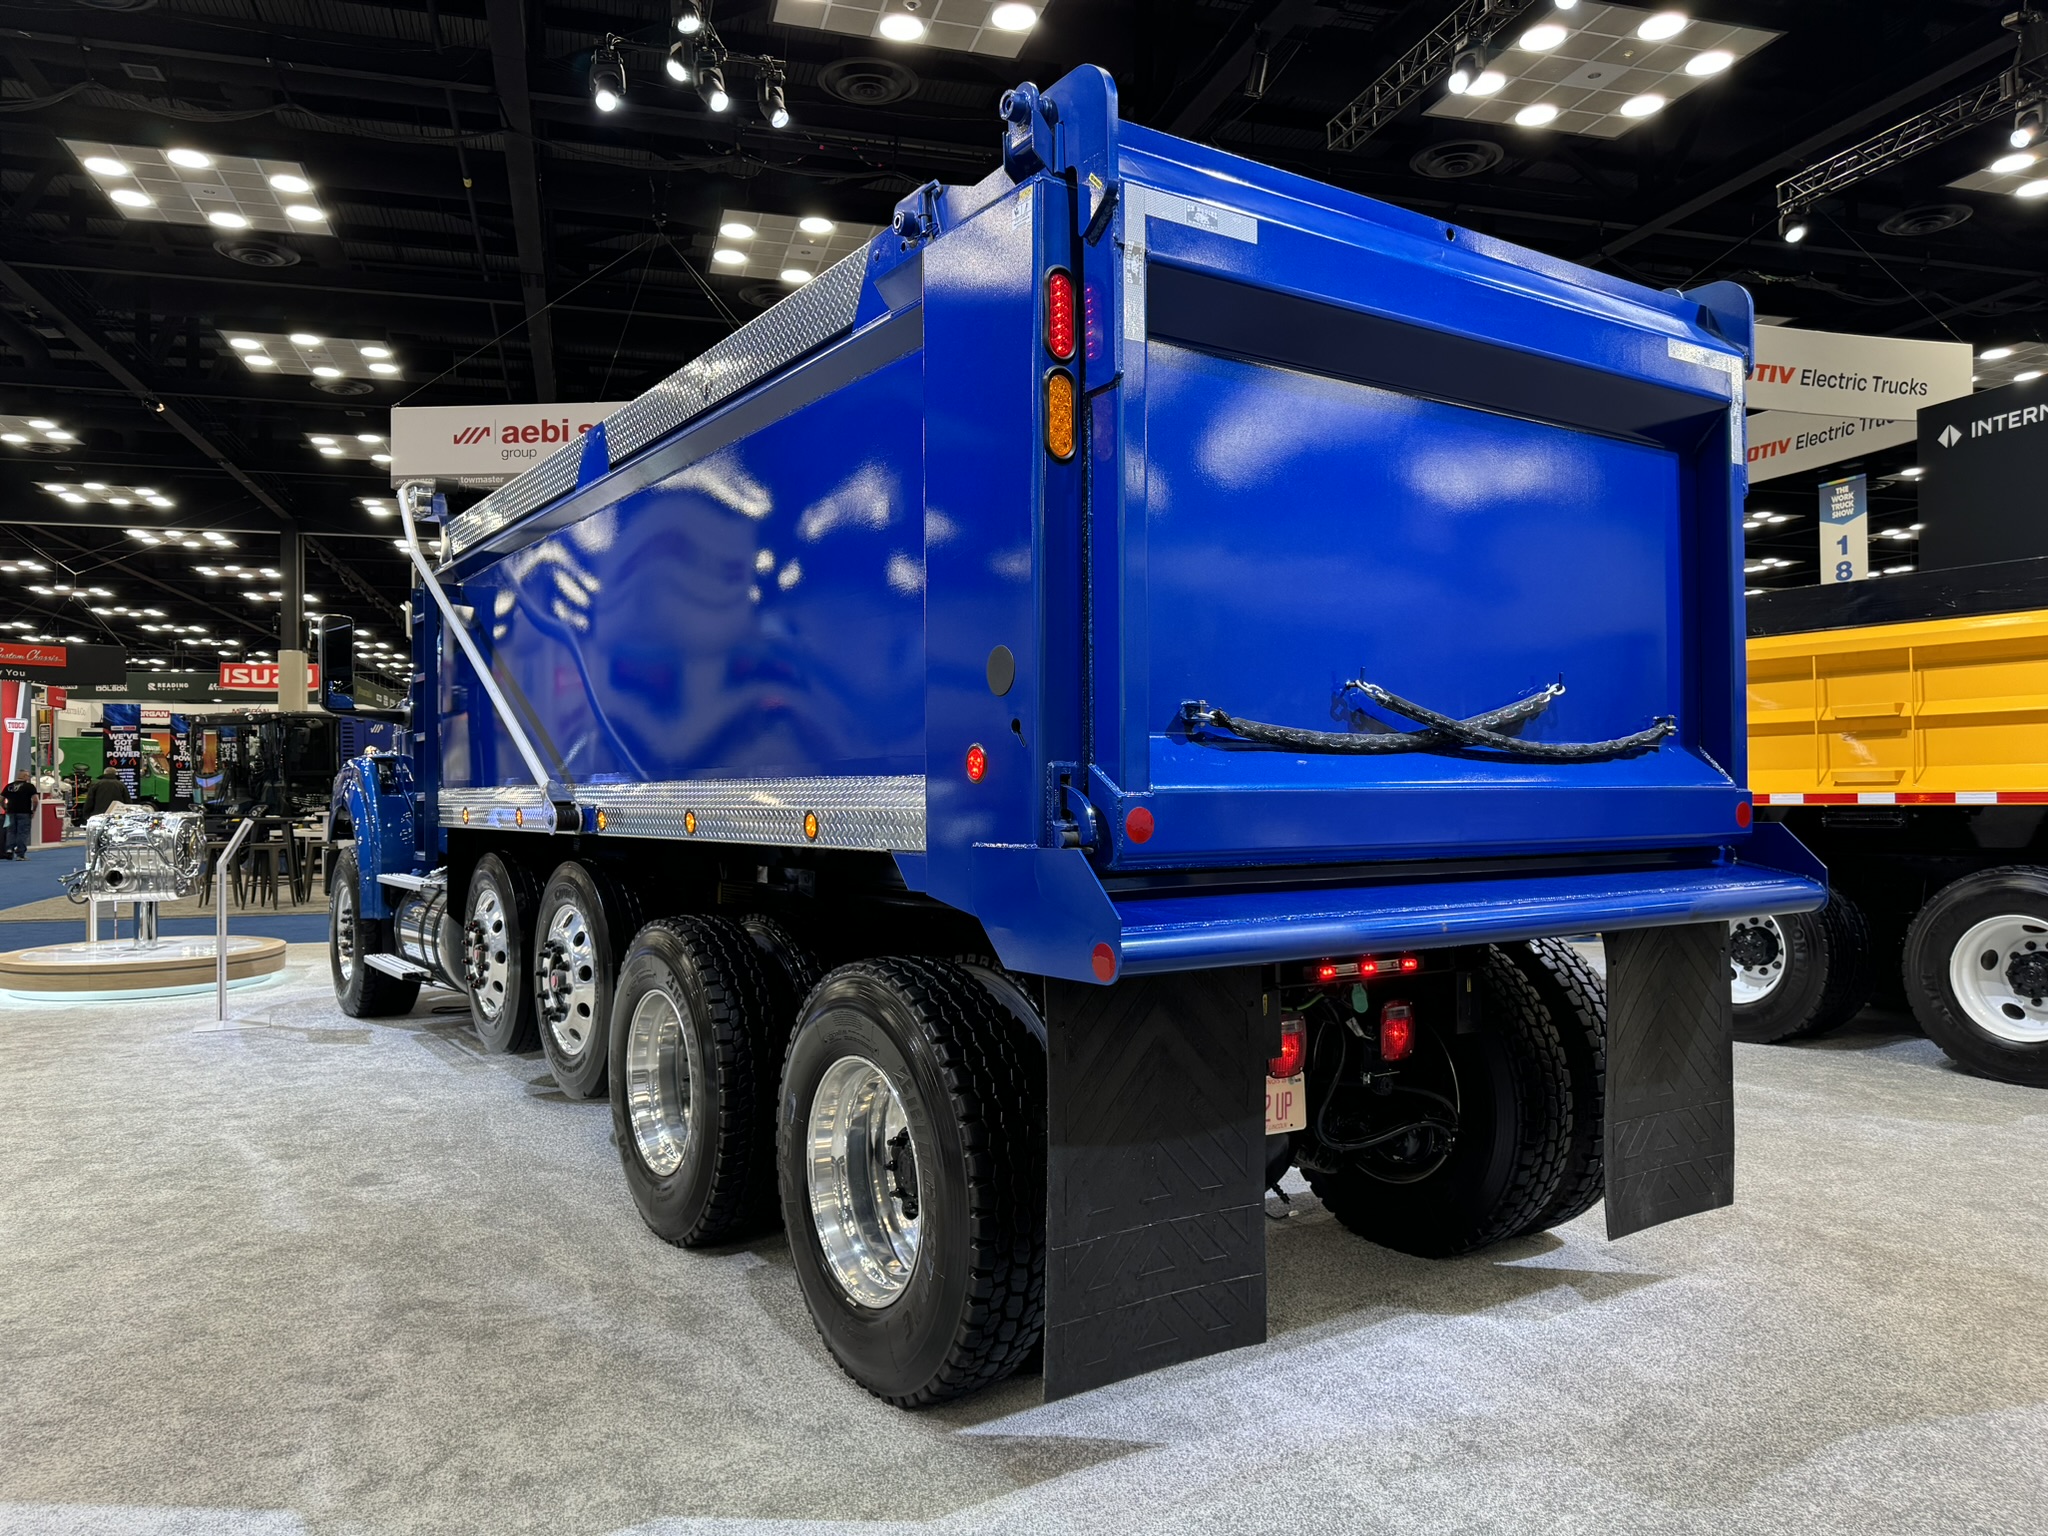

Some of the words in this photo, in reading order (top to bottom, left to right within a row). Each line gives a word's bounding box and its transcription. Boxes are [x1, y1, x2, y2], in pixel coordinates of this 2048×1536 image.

[1747, 363, 1796, 385] TIV
[1799, 369, 1868, 392] Electric
[1871, 375, 1928, 396] Trucks
[1971, 404, 2048, 439] INTERN
[501, 418, 569, 444] aebi
[1747, 437, 1792, 463] OTIV
[1795, 420, 1855, 450] Electric
[1859, 417, 1895, 432] Tru
[501, 448, 538, 461] group
[460, 475, 505, 484] towmaster
[1835, 485, 1849, 495] THE
[1831, 491, 1855, 503] WORK
[1831, 500, 1855, 511] TRUCK
[1831, 508, 1854, 519] SHOW
[1836, 535, 1848, 556] 1
[1835, 560, 1853, 582] 8
[26, 649, 64, 662] Chassis
[6, 669, 26, 677] You
[223, 668, 313, 685] ISU
[141, 710, 169, 718] RGAN
[7, 721, 25, 730] TODCO
[1276, 1090, 1293, 1121] UP
